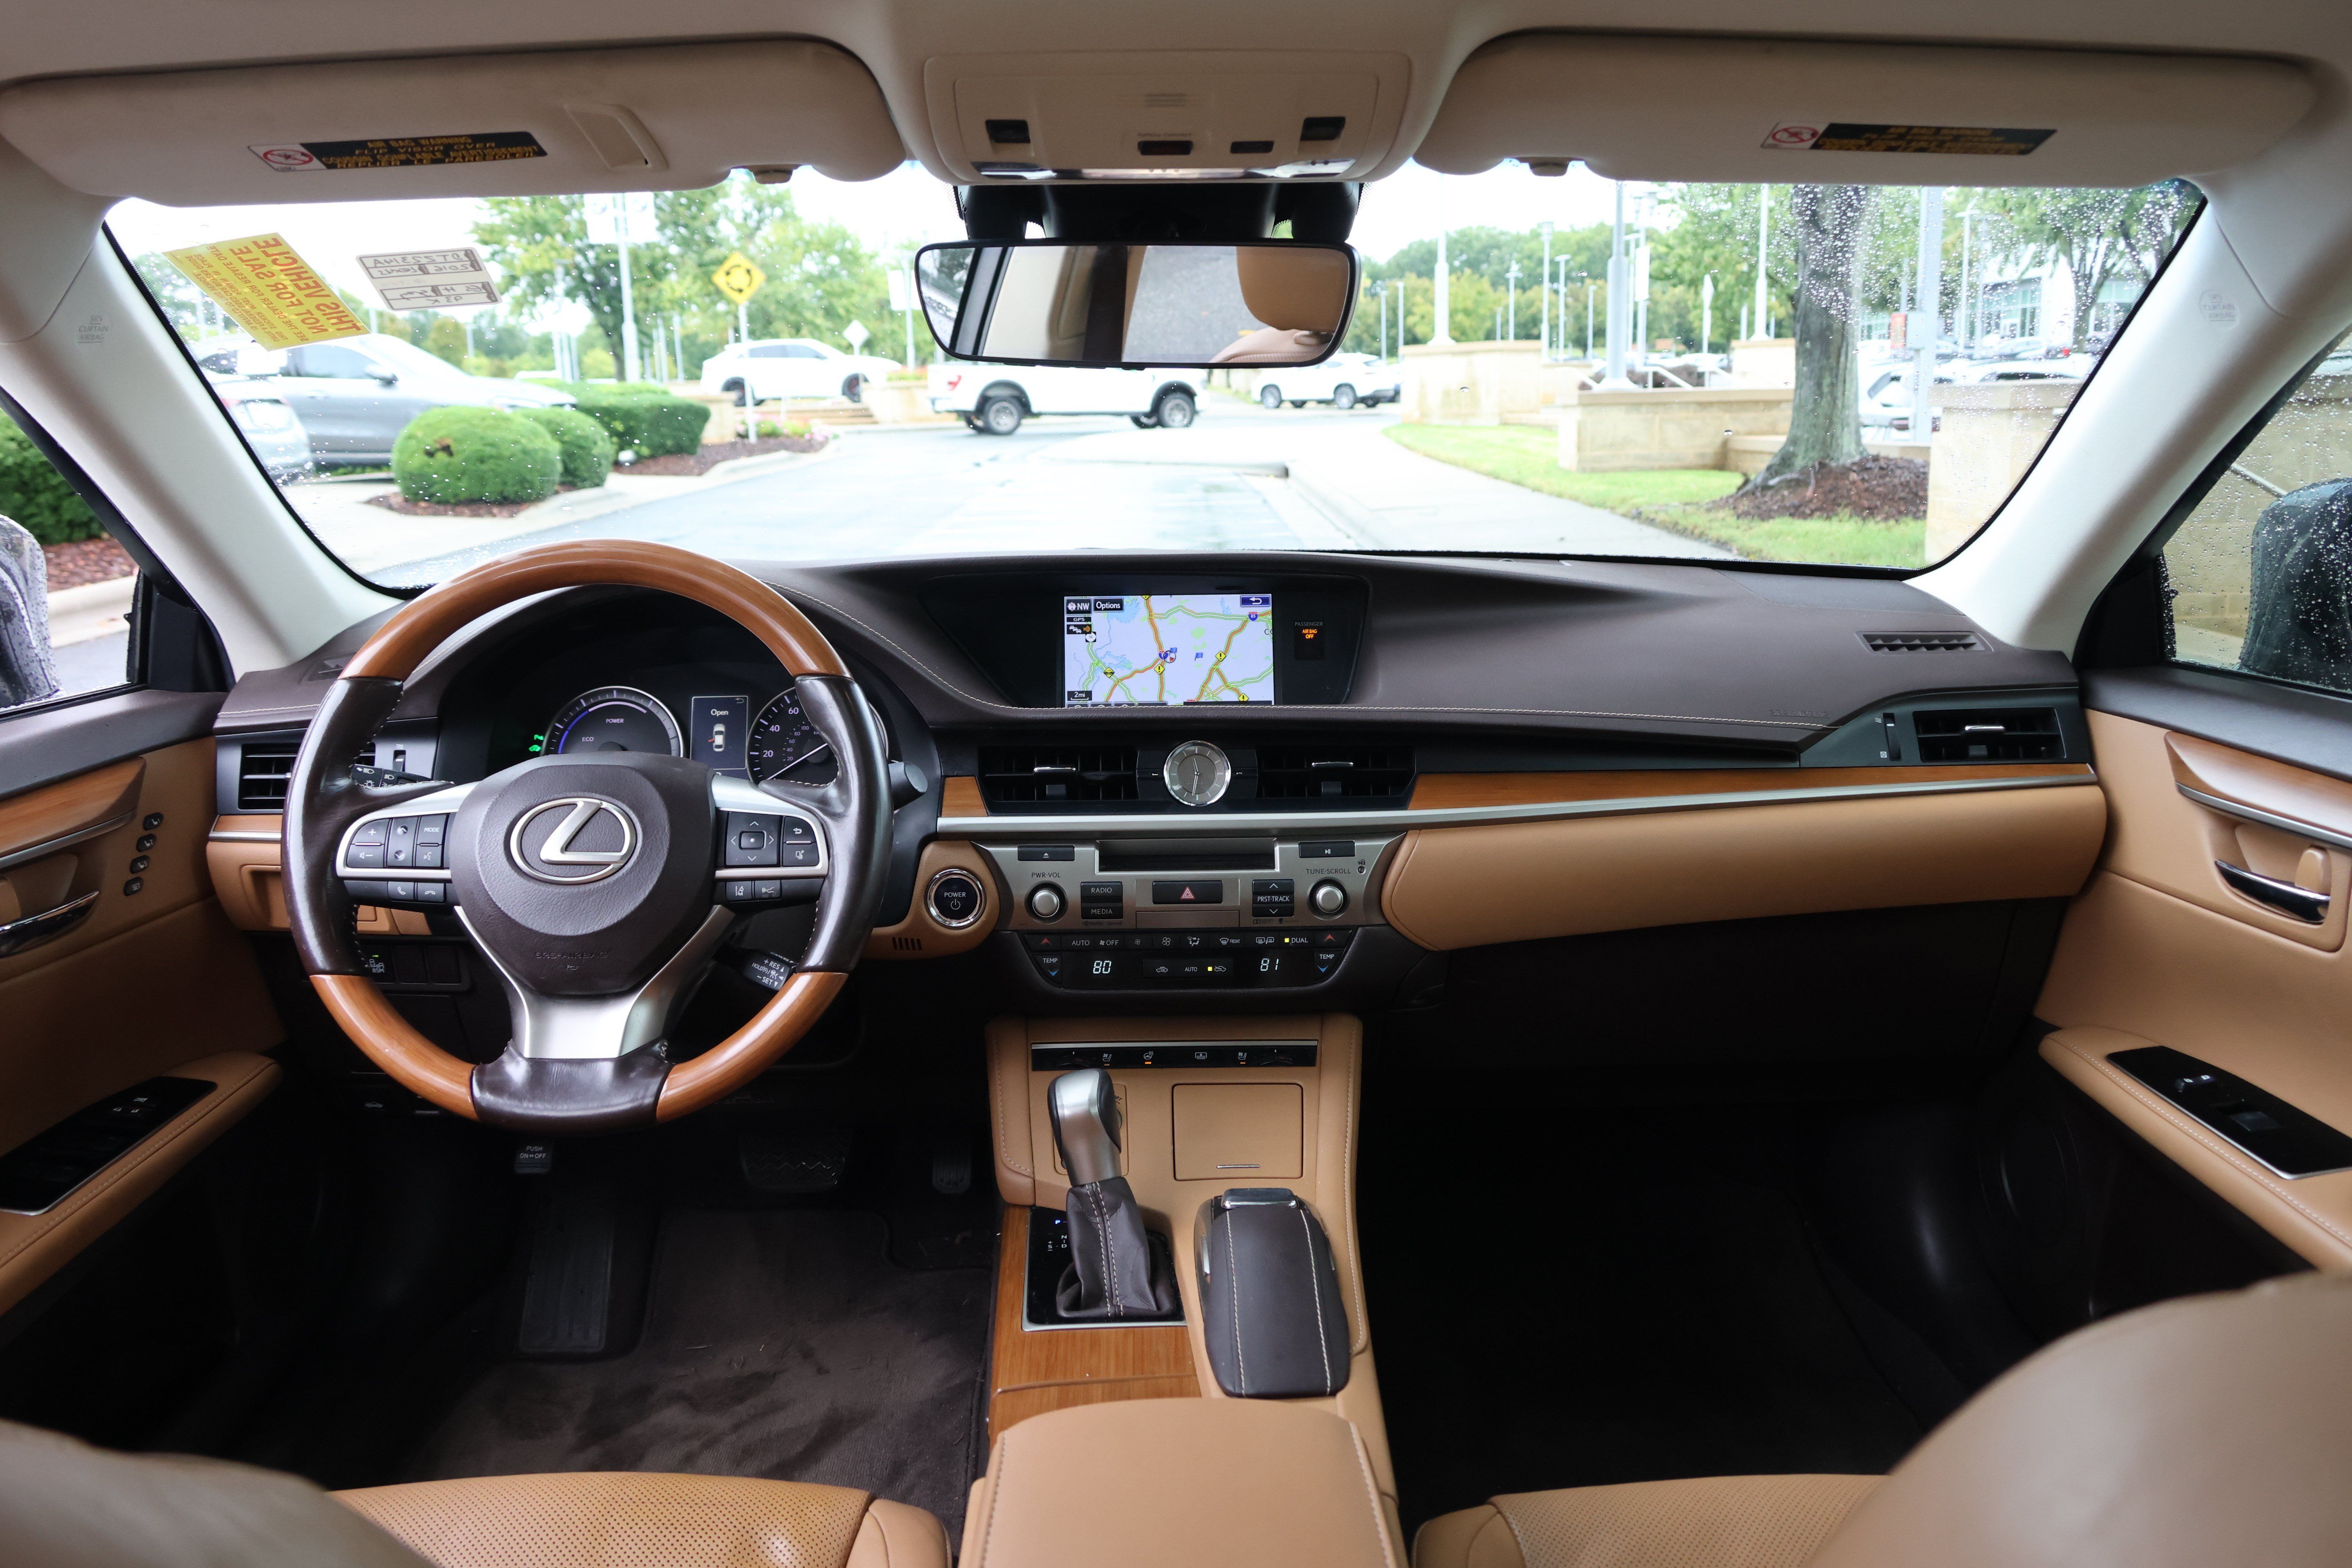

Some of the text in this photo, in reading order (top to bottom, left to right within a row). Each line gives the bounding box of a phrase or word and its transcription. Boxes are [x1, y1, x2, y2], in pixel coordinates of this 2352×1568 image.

[1096, 601, 1120, 610] Options
[710, 708, 728, 717] Open
[751, 962, 764, 971] HOLD
[769, 961, 780, 970] RES
[1093, 960, 1111, 974] 80
[1260, 958, 1279, 971] 81
[762, 976, 773, 985] SET
